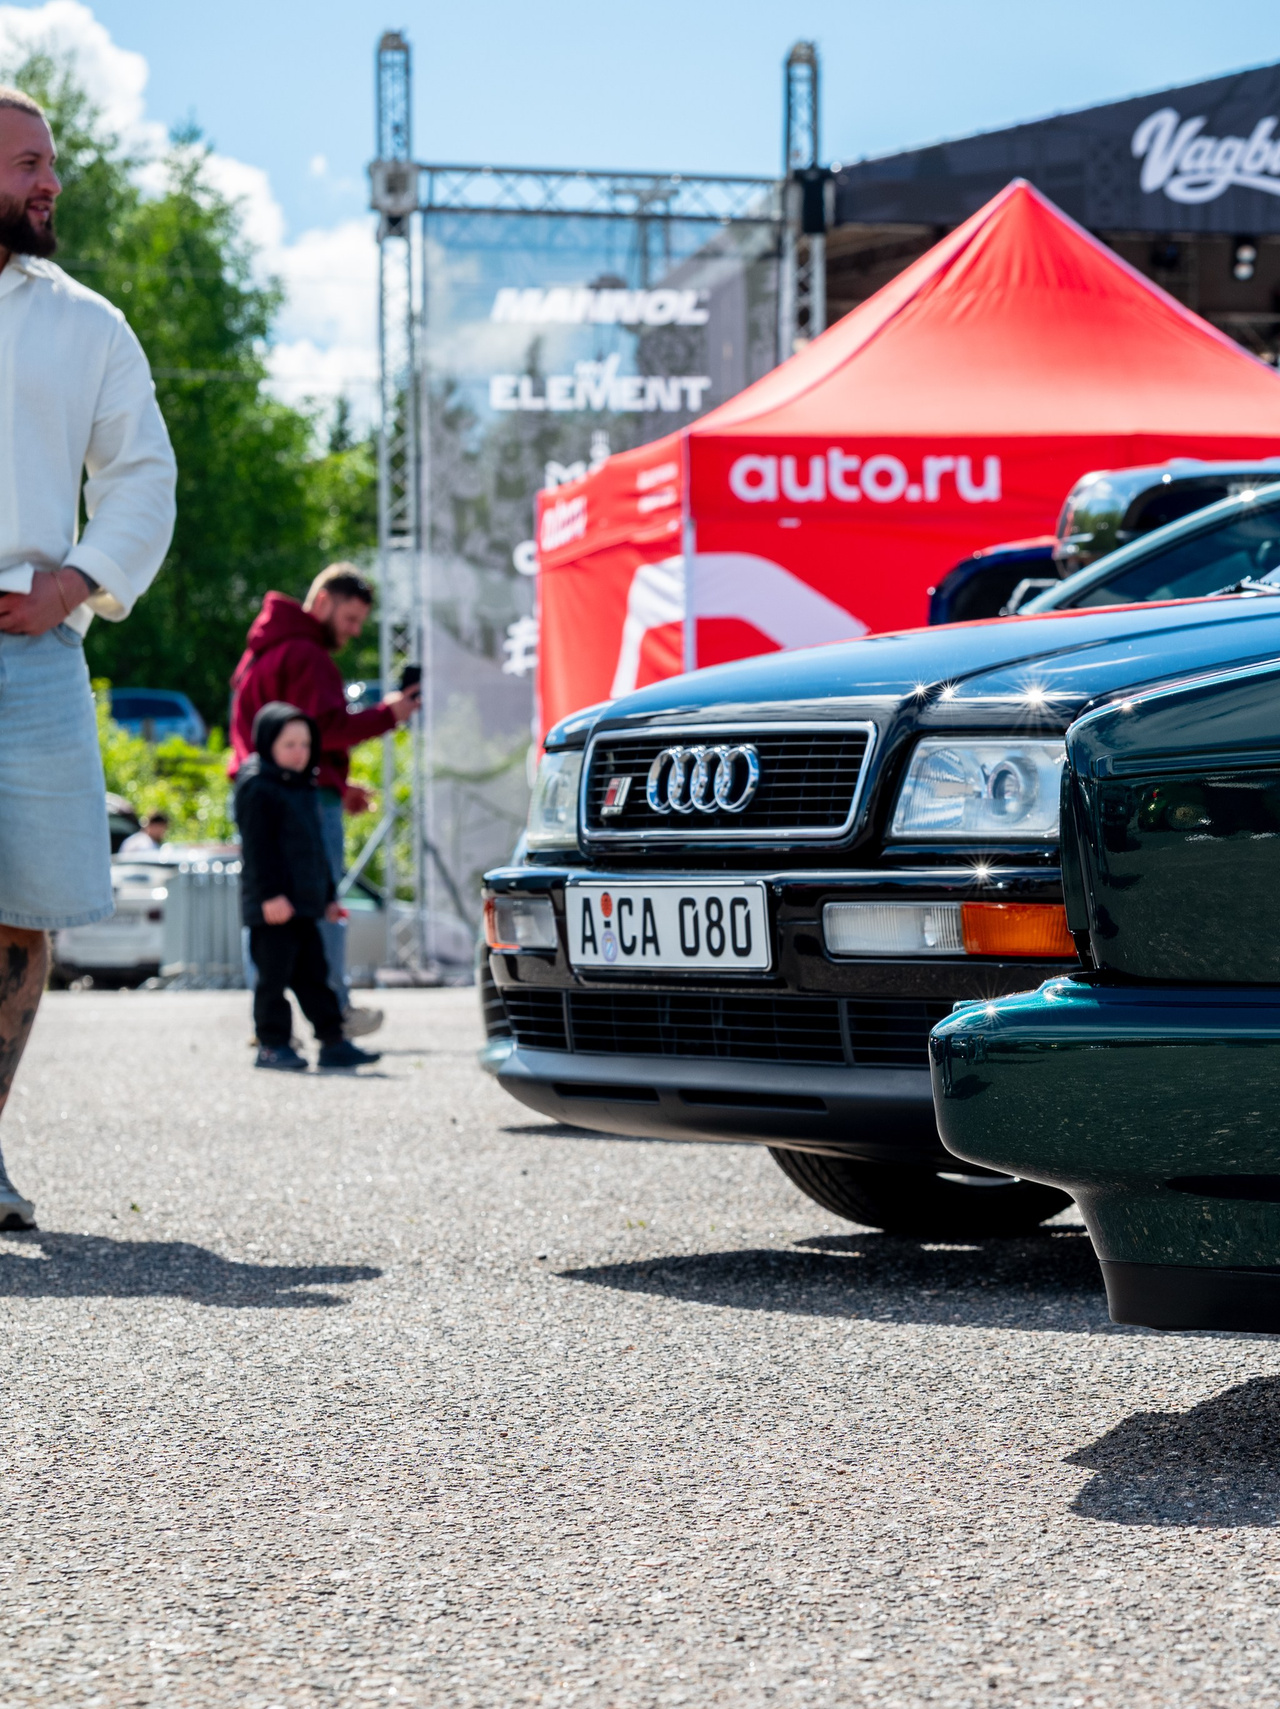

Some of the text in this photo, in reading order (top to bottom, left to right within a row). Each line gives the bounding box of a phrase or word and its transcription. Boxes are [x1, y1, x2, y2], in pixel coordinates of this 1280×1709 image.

[490, 373, 711, 412] ELEMENT
[728, 446, 1002, 503] auto.ru
[581, 896, 752, 958] A CA 080
